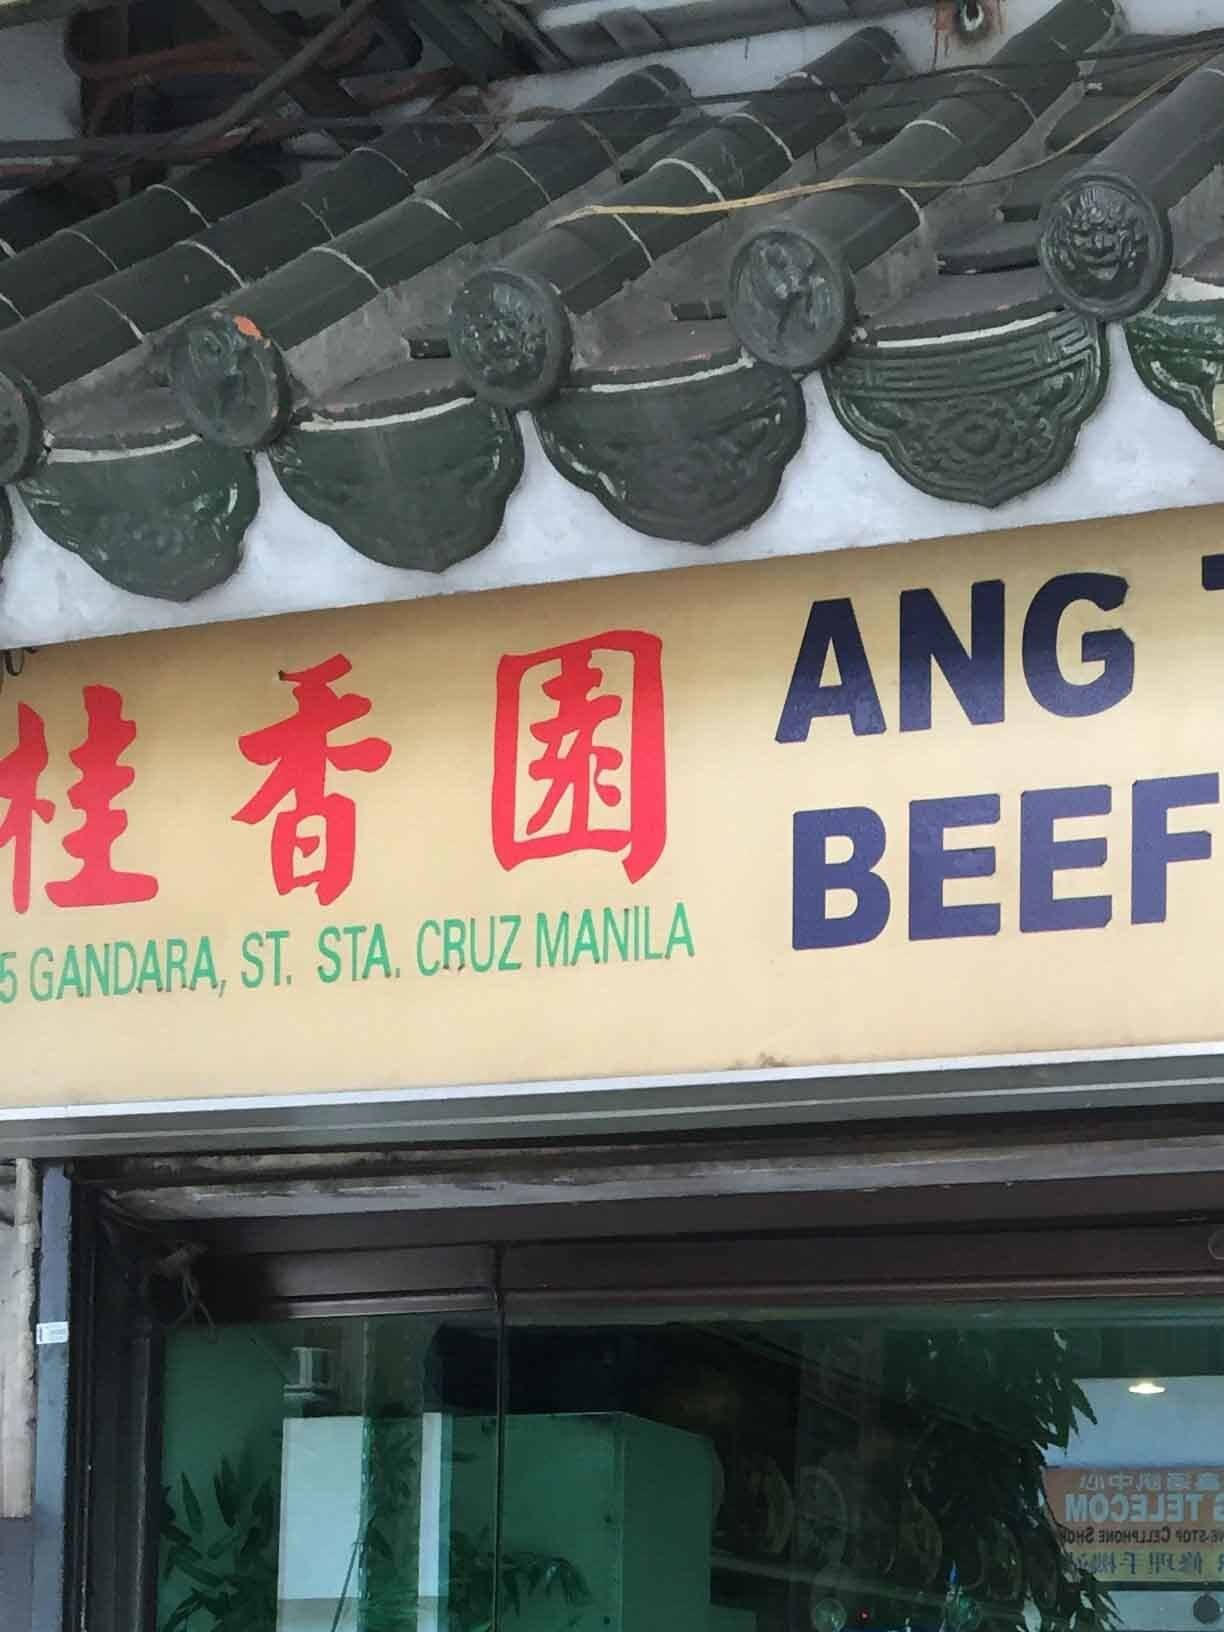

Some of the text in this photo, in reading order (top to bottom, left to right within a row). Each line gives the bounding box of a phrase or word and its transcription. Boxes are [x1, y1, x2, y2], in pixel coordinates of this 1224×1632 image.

[775, 571, 1135, 743] ANG
[792, 772, 1219, 951] BEEF
[30, 935, 228, 1002] GANDARA,
[241, 928, 293, 989] ST.
[317, 923, 401, 984] STA.
[416, 914, 523, 978] CRUZ
[535, 902, 697, 966] MANILA
